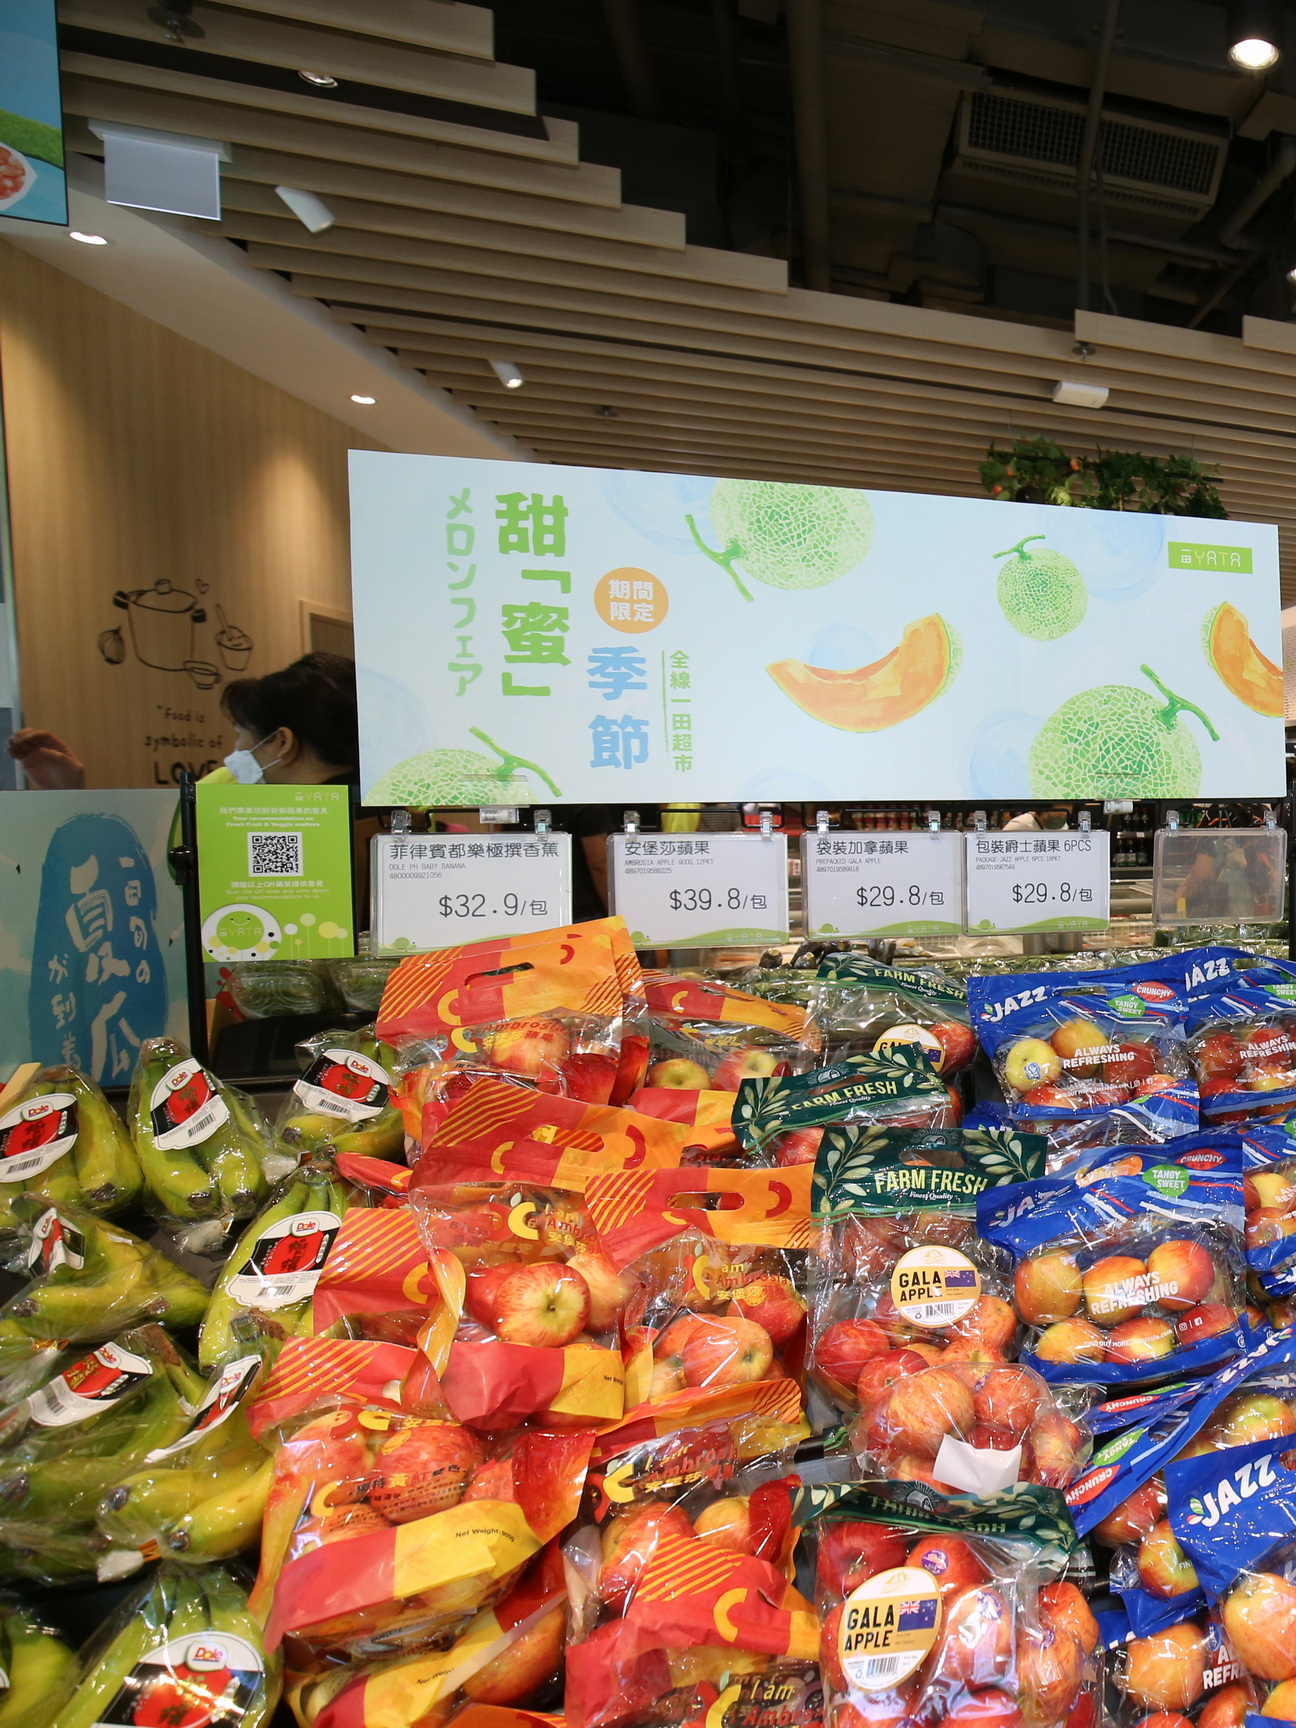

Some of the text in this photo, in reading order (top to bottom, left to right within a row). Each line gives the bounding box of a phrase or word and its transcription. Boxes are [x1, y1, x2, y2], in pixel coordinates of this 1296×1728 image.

[1194, 550, 1242, 569] YATA
[446, 487, 483, 697] メロンフェア
[495, 491, 572, 697] 甜「蜜」
[608, 579, 654, 601] 期間
[609, 602, 655, 622] 限定
[587, 646, 649, 770] 季節
[669, 649, 693, 772] 全線一田超市
[144, 733, 223, 749] symbolic of
[390, 841, 560, 860] 菲律賓都樂極撰香蕉
[624, 840, 710, 856] 安堡莎蘋果
[816, 839, 909, 856] 袋裝加拿蘋果
[976, 839, 1092, 854] 包裝爵士蘋果 6PCS
[669, 888, 767, 912] $39.8/包
[856, 884, 945, 908] $29.8/包
[1011, 882, 1093, 905] $29.8/包
[438, 893, 548, 918] $32.9/包
[874, 968, 964, 1000] FARM FRESH
[1136, 985, 1173, 1000] CRUNCHY
[991, 985, 1047, 1022] JAZZ
[1113, 1001, 1139, 1010] TANGY
[1118, 1006, 1143, 1016] SWEET
[1074, 1044, 1121, 1058] ALWAYS
[1248, 1035, 1288, 1051] ALWAYS
[350, 1060, 369, 1071] Dole
[1063, 1051, 1135, 1069] REFRESHING
[172, 1070, 189, 1088] Dole
[847, 1081, 898, 1101] FRESH
[28, 1103, 50, 1118] Dole
[1179, 1153, 1224, 1168] CRUNCHY
[874, 1168, 988, 1195] FARM FRESH
[1151, 1169, 1181, 1181] TANGY
[1157, 1178, 1186, 1191] SWEET
[296, 1221, 317, 1232] Dole
[899, 1271, 941, 1288] GALA
[1103, 1271, 1161, 1297] ALWAYS
[900, 1286, 942, 1302] APPLE
[1090, 1280, 1179, 1316] REFRESHING
[1200, 1454, 1276, 1527] JAZZ
[847, 1605, 894, 1630] GALA
[844, 1630, 893, 1651] APPLE
[193, 1646, 223, 1661] Dole
[764, 1685, 794, 1700] am
